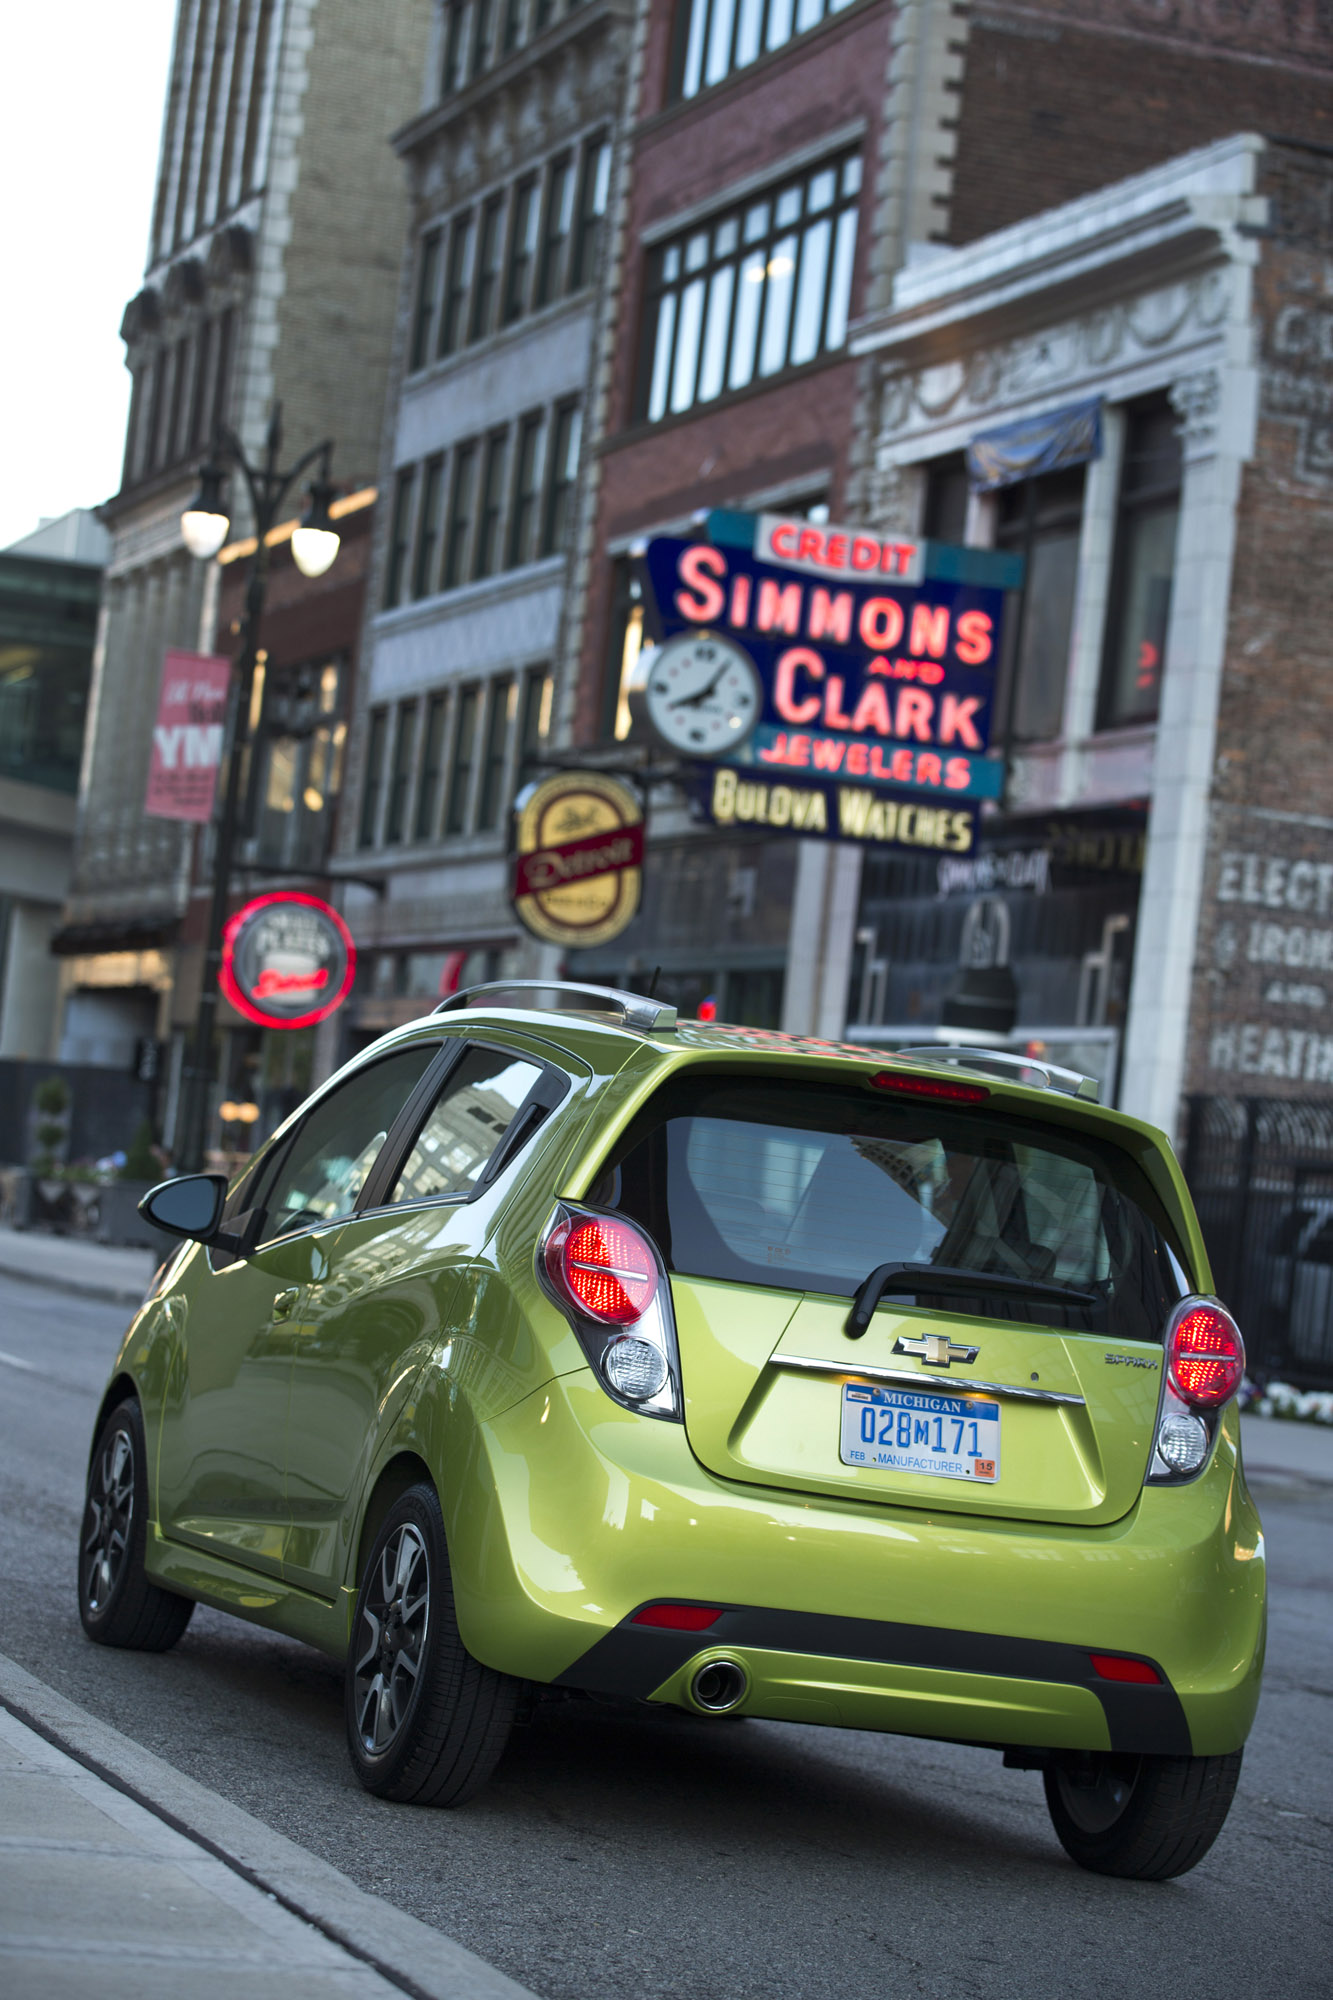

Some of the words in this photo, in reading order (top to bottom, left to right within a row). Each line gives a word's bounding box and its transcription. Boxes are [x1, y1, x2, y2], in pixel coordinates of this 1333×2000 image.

[770, 523, 917, 575] CREDIT
[675, 545, 994, 665] SIMMONS
[869, 656, 946, 685] AND
[775, 646, 983, 749] CLARK
[761, 733, 971, 790] JEWELERS
[713, 768, 826, 830] BULOVA
[838, 785, 973, 852] WATCHES
[1104, 1353, 1158, 1370] SPARK
[883, 1391, 961, 1413] MICHIGAN
[861, 1407, 982, 1457] 028M171
[850, 1450, 865, 1461] FEB
[878, 1453, 962, 1473] MANUFACTURER
[980, 1462, 992, 1471] 15
